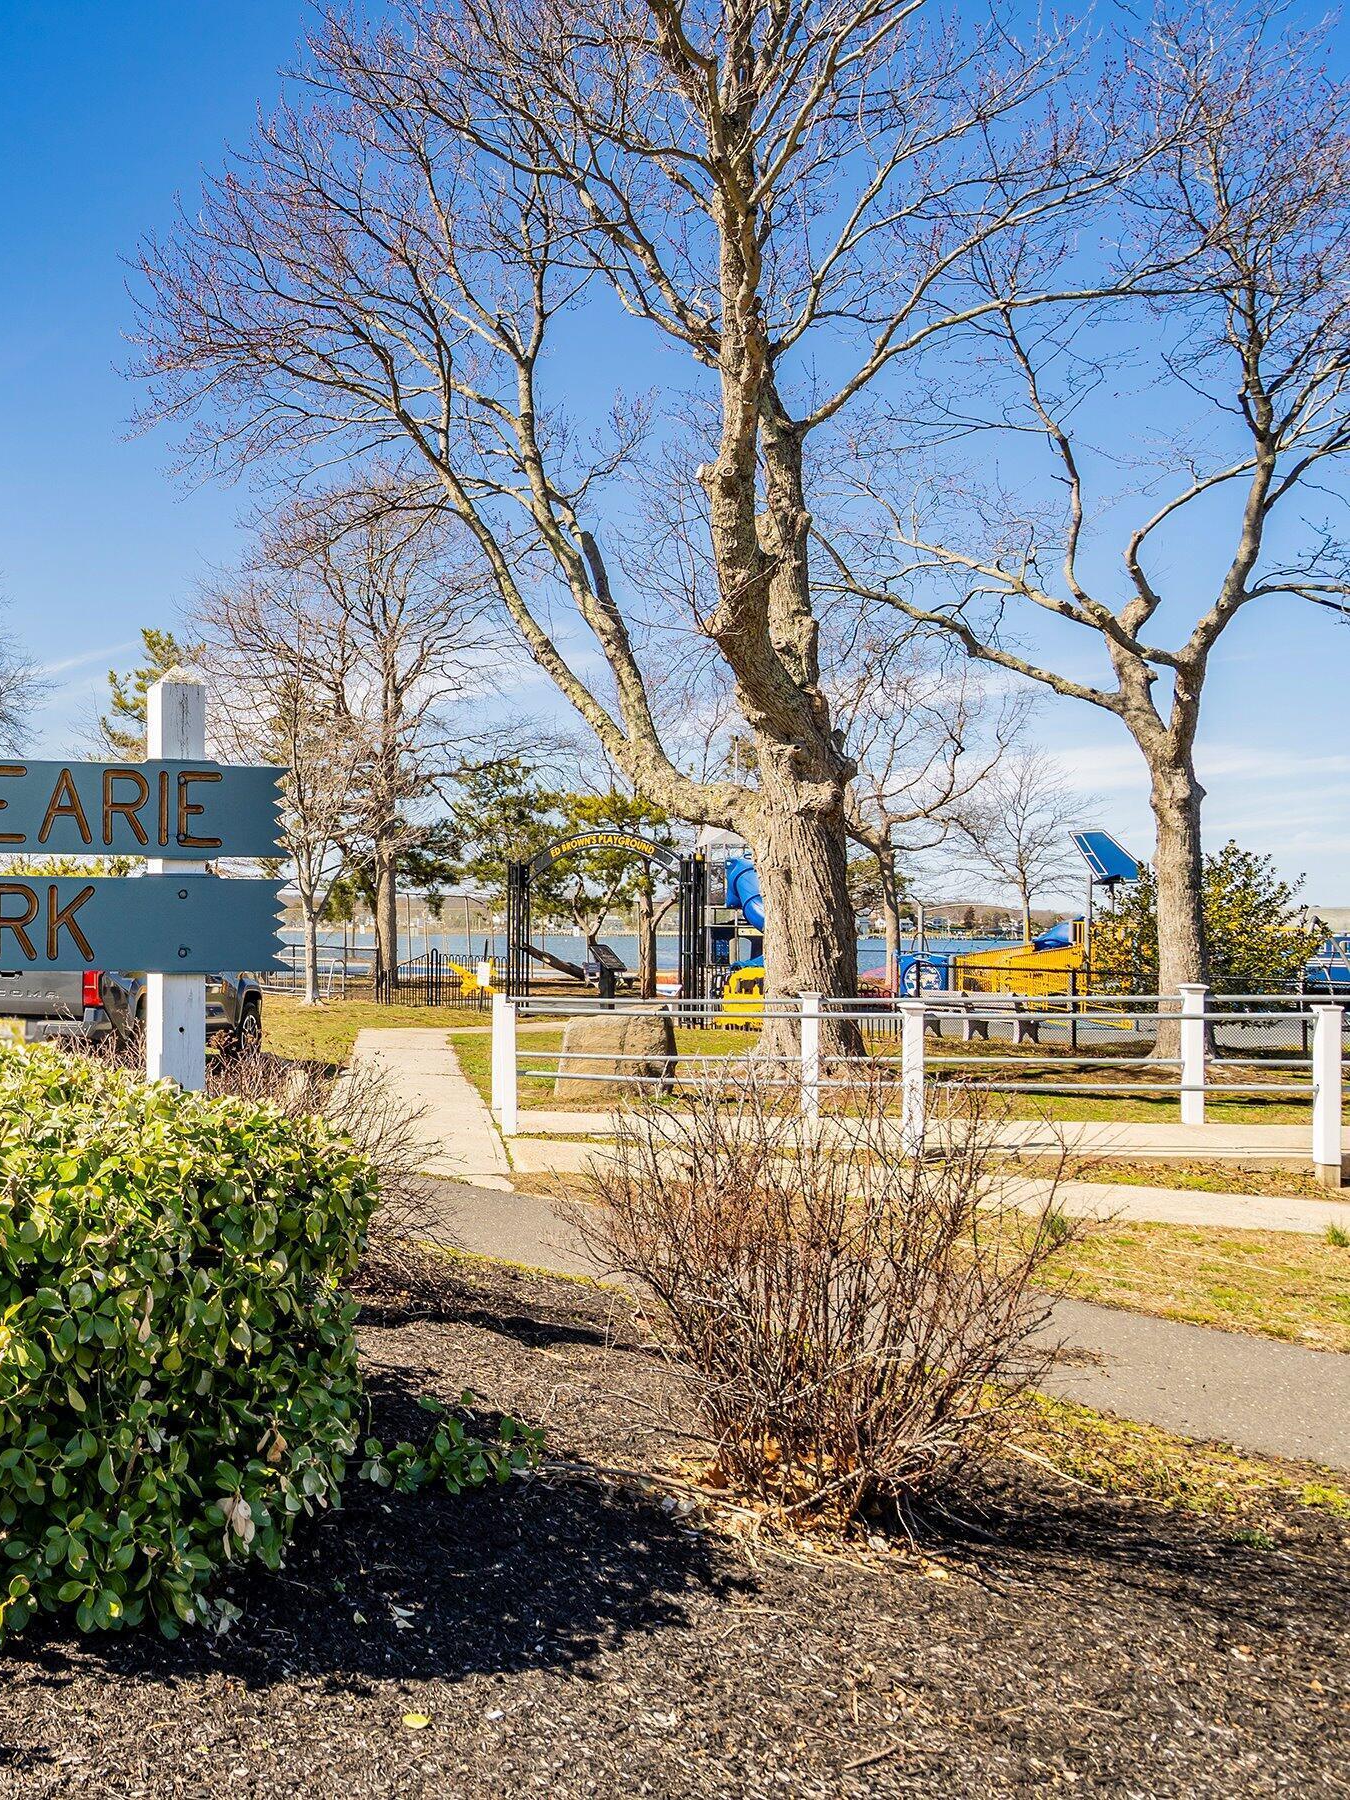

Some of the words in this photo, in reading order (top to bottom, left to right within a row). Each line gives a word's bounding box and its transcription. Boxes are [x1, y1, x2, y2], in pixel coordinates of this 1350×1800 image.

[550, 847, 561, 858] ED
[562, 835, 597, 853] BROWN'S
[598, 834, 655, 855] PLAYGROUND
